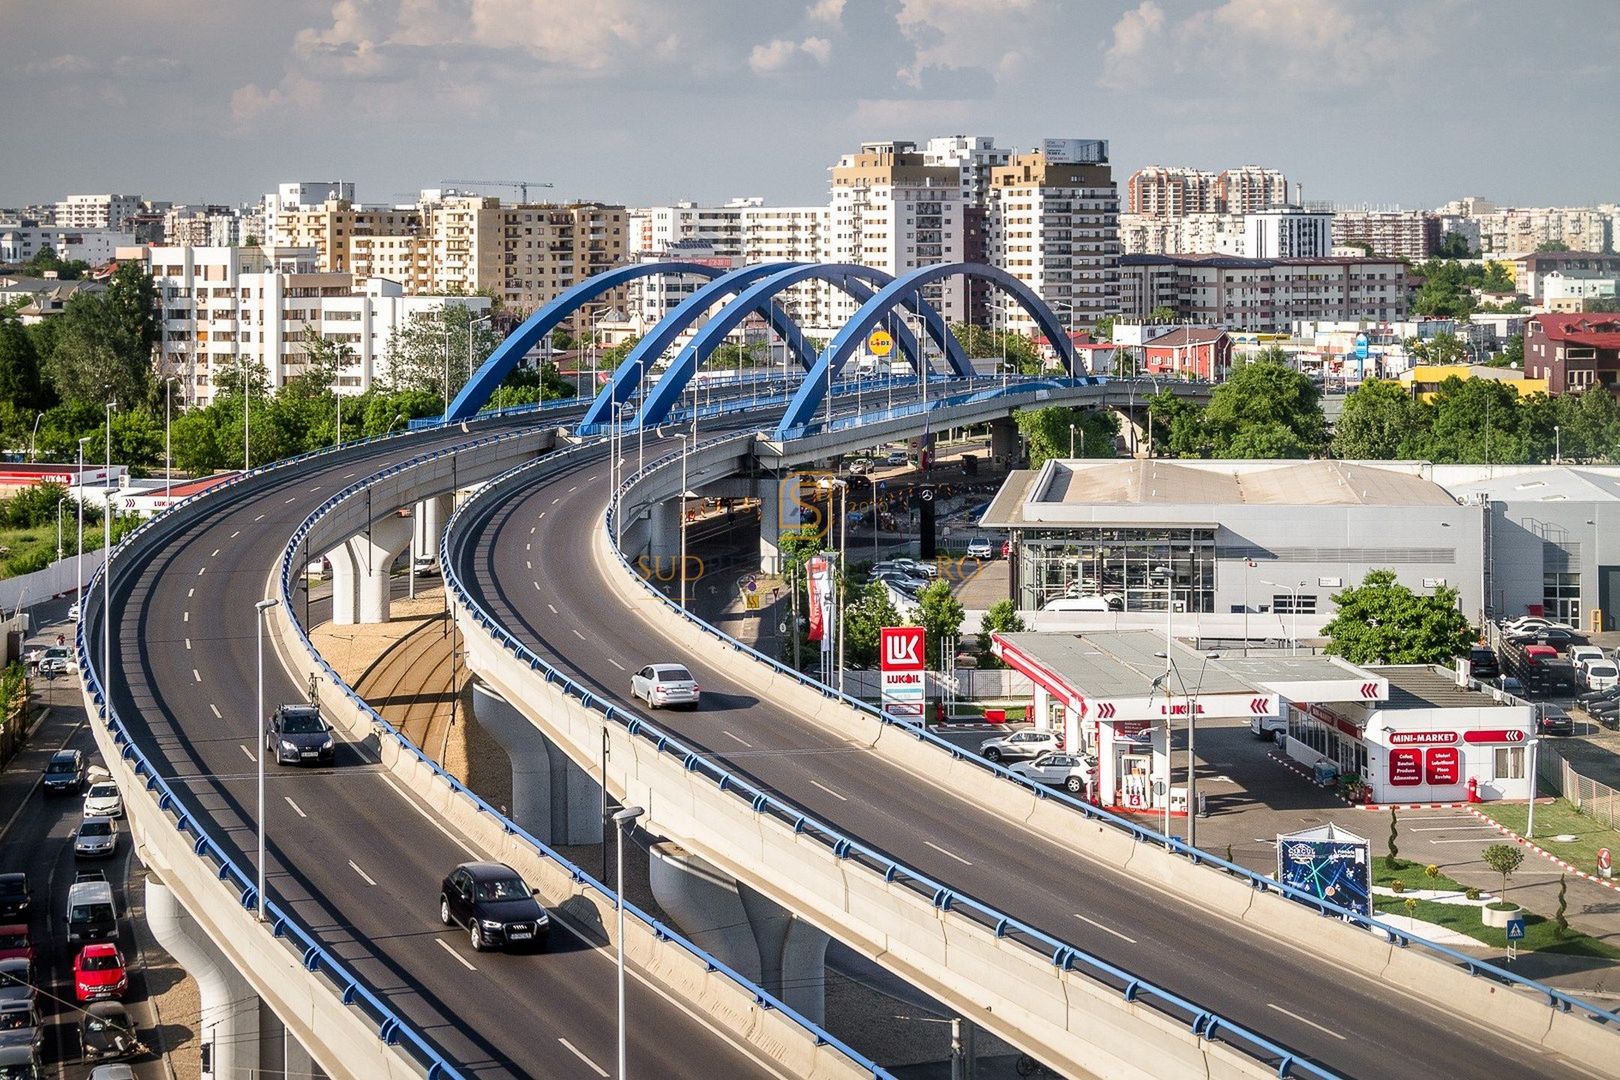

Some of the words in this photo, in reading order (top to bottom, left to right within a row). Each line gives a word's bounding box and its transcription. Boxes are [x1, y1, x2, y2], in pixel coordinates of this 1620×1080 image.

[886, 635, 920, 665] LUK
[887, 673, 921, 684] LUKOIL
[1393, 733, 1455, 743] MINI-MARKET
